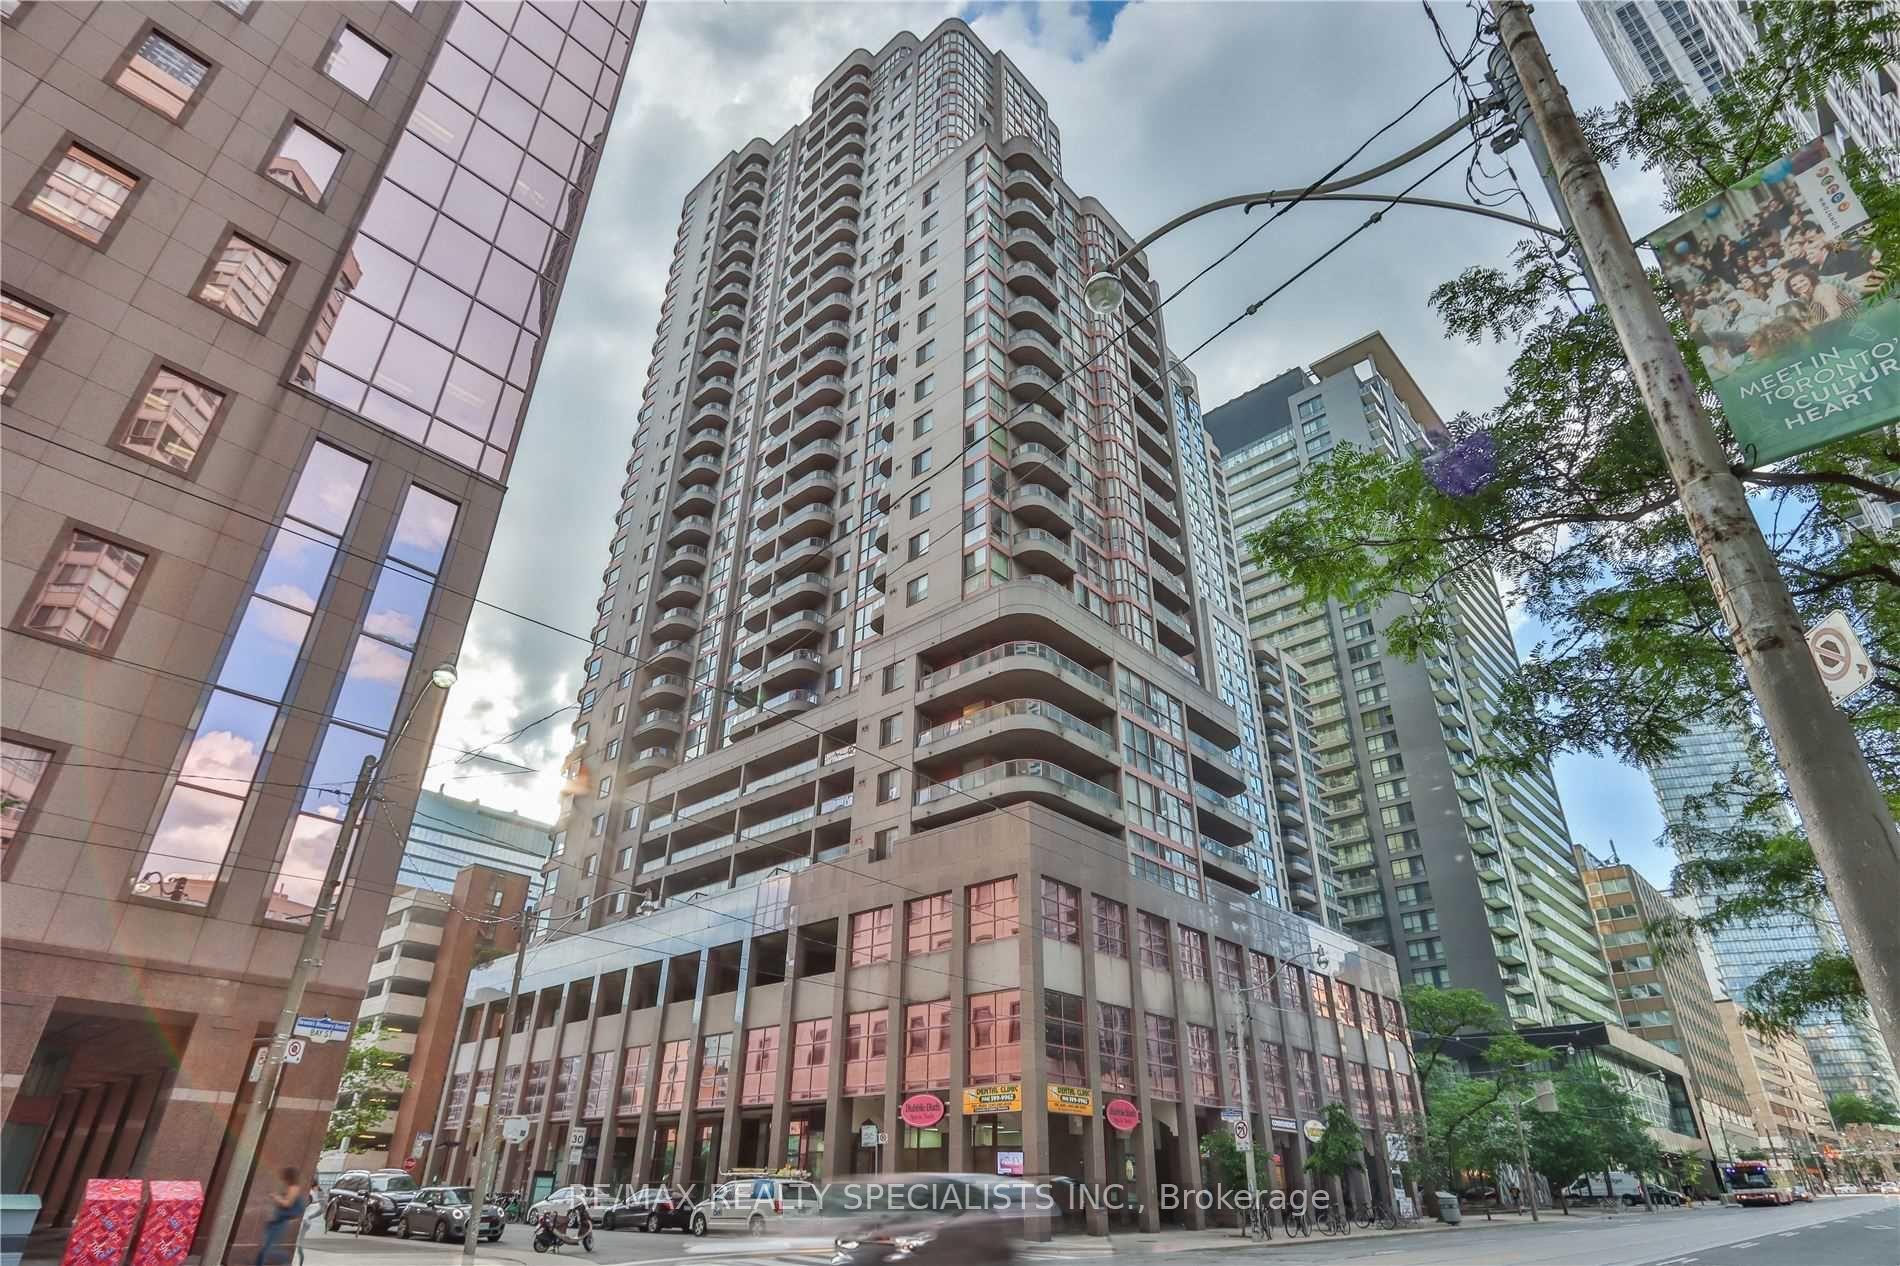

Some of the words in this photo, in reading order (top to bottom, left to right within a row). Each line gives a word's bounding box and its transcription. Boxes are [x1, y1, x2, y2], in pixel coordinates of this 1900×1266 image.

[1740, 361, 1803, 399] MEET
[1810, 346, 1841, 368] IN
[1784, 386, 1873, 430] HEART
[976, 1087, 998, 1096] DENTAL
[572, 1134, 584, 1144] 30
